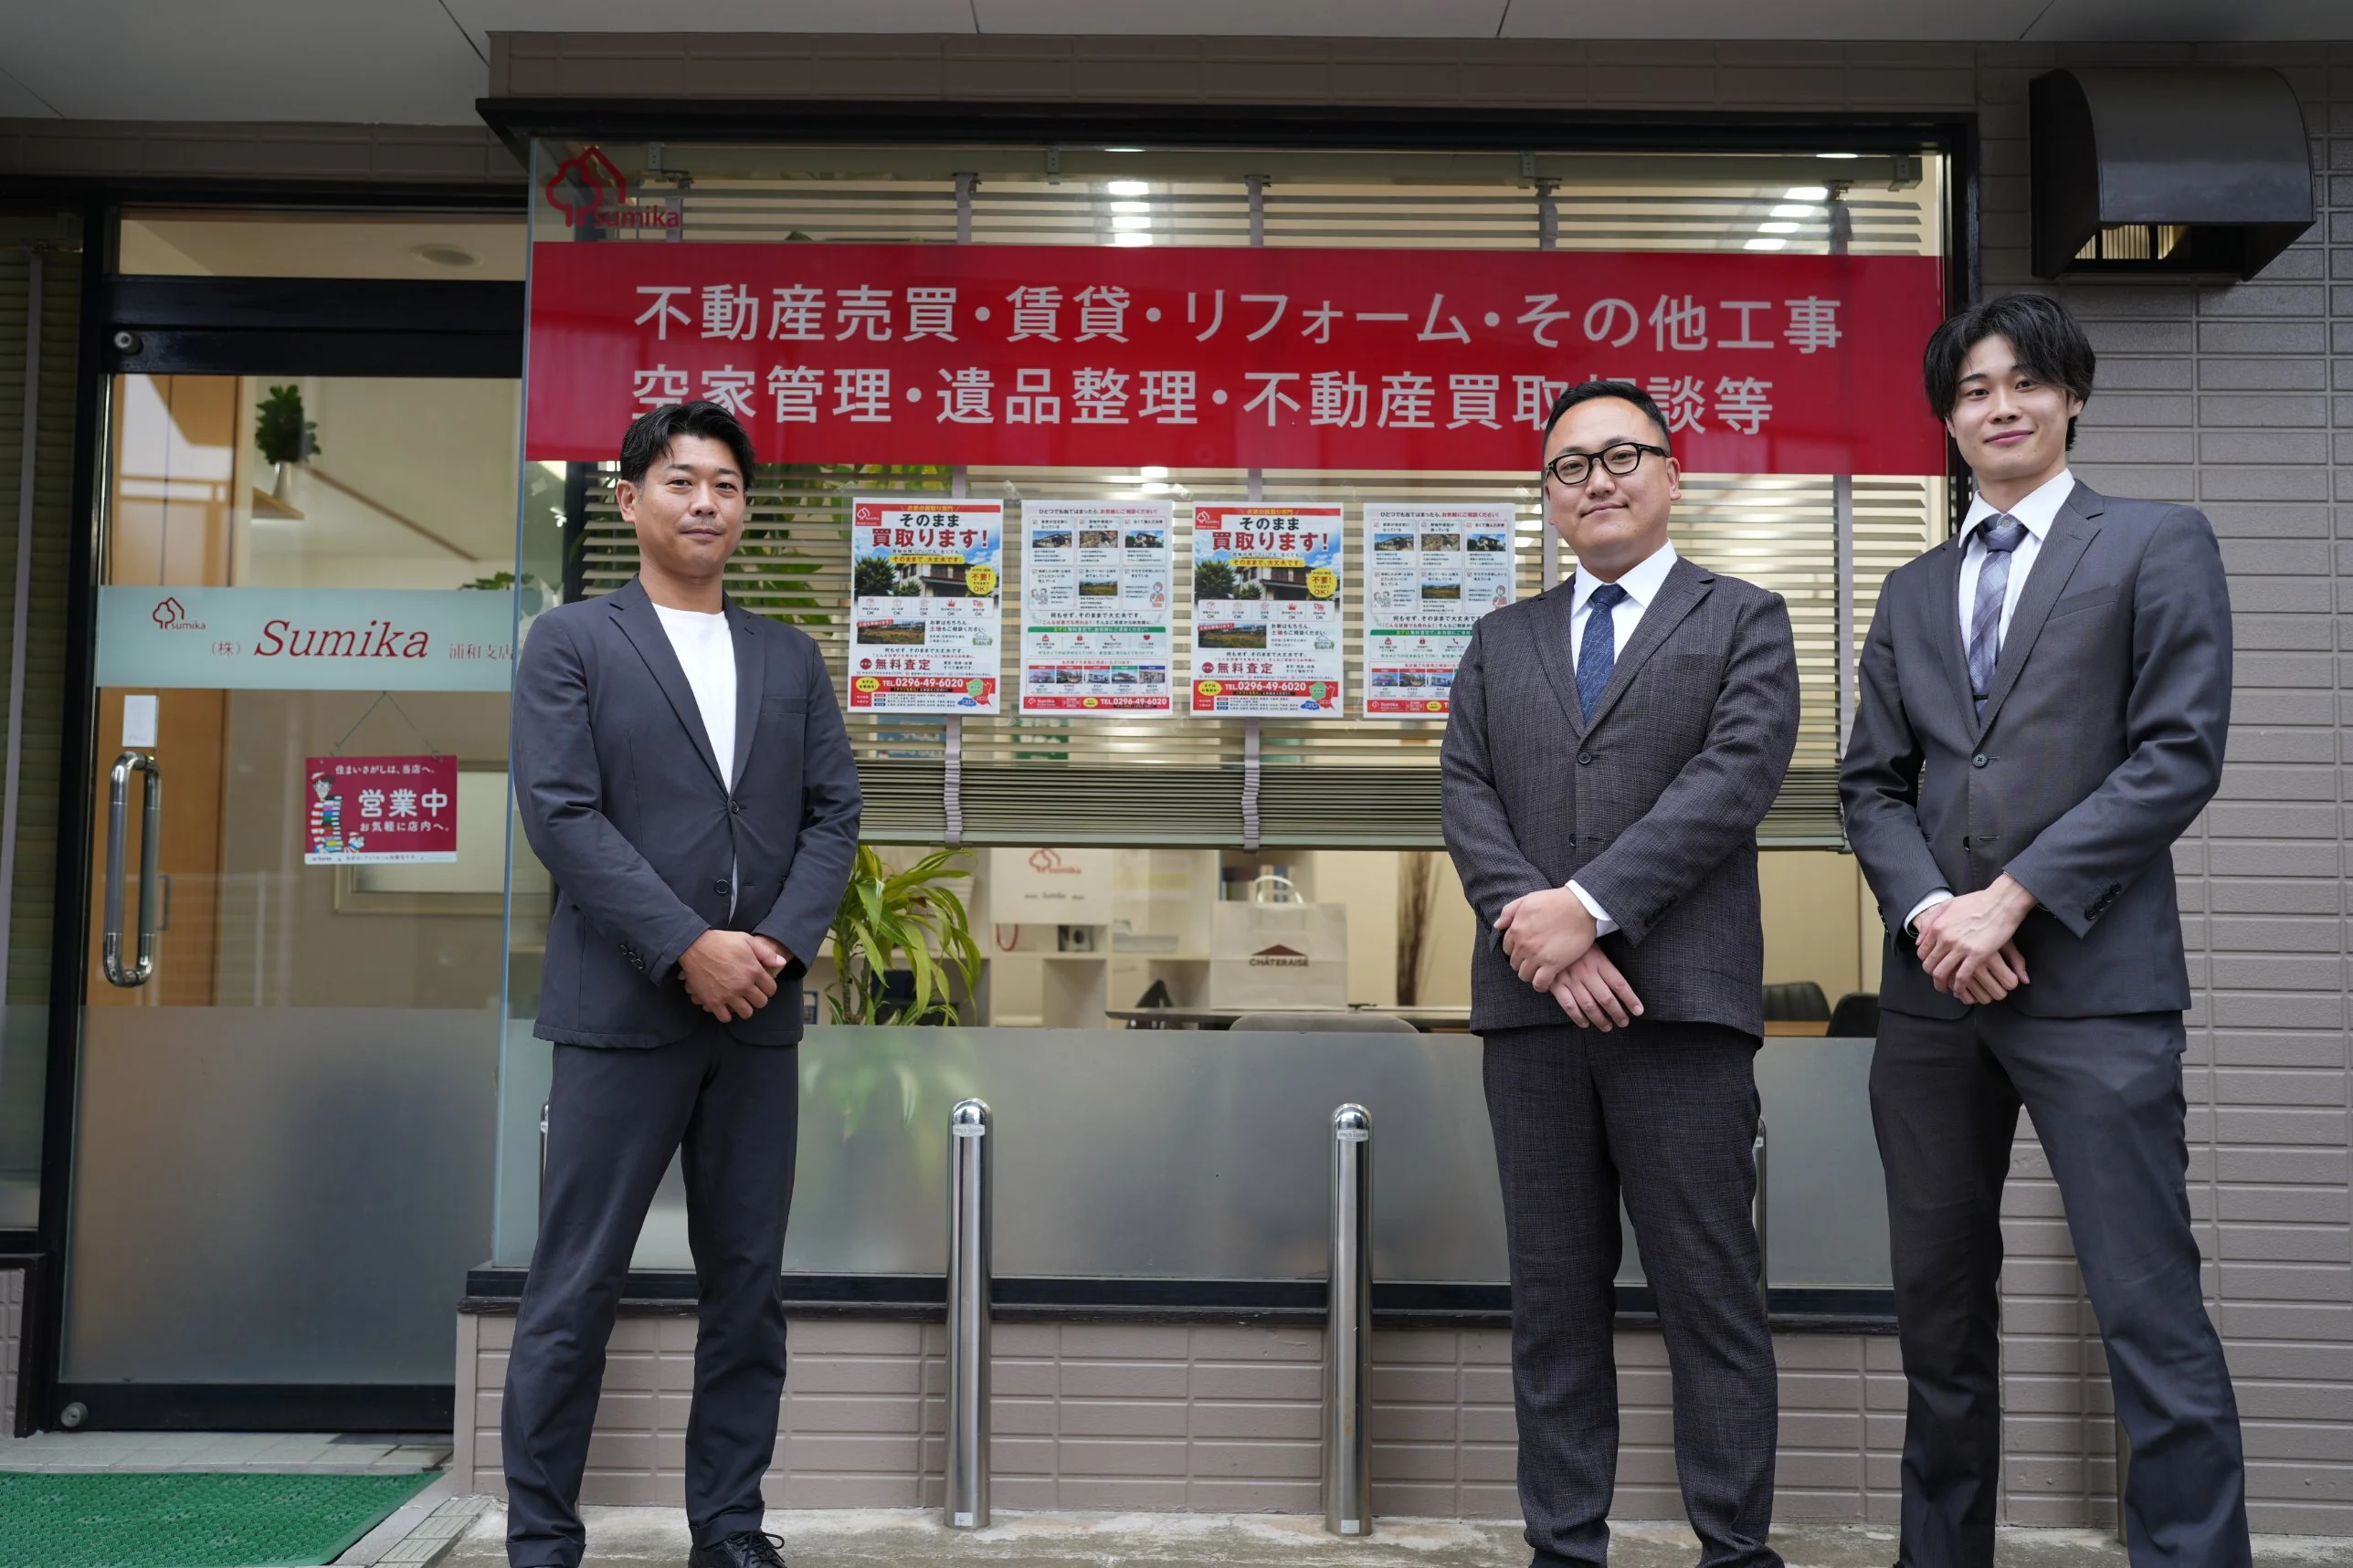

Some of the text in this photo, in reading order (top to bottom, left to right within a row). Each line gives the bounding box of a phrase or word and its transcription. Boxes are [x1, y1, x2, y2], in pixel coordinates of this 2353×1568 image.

[596, 205, 680, 228] sumika
[635, 283, 1843, 354] 不動産売買・賃貸・リフォーム・その他工事
[632, 363, 1775, 436] 空家管理・遺品整理・不動産買取談等
[900, 513, 959, 527] そのまま
[1240, 517, 1300, 531] そのまま
[872, 529, 987, 548] 買取ります!
[1212, 532, 1328, 552] 買取ります!
[171, 621, 206, 630] sumika
[254, 619, 430, 658] Sumika
[875, 659, 931, 670] 無料査定
[1218, 663, 1273, 674] 無料査定
[882, 678, 964, 688] TEL.0296-49-6020
[1225, 681, 1306, 691] TEL.0296-49-6020
[335, 764, 435, 775] 住まいさがしは、当店へ。
[358, 788, 448, 818] 営業中
[360, 821, 449, 832] お気軽に店内へ。
